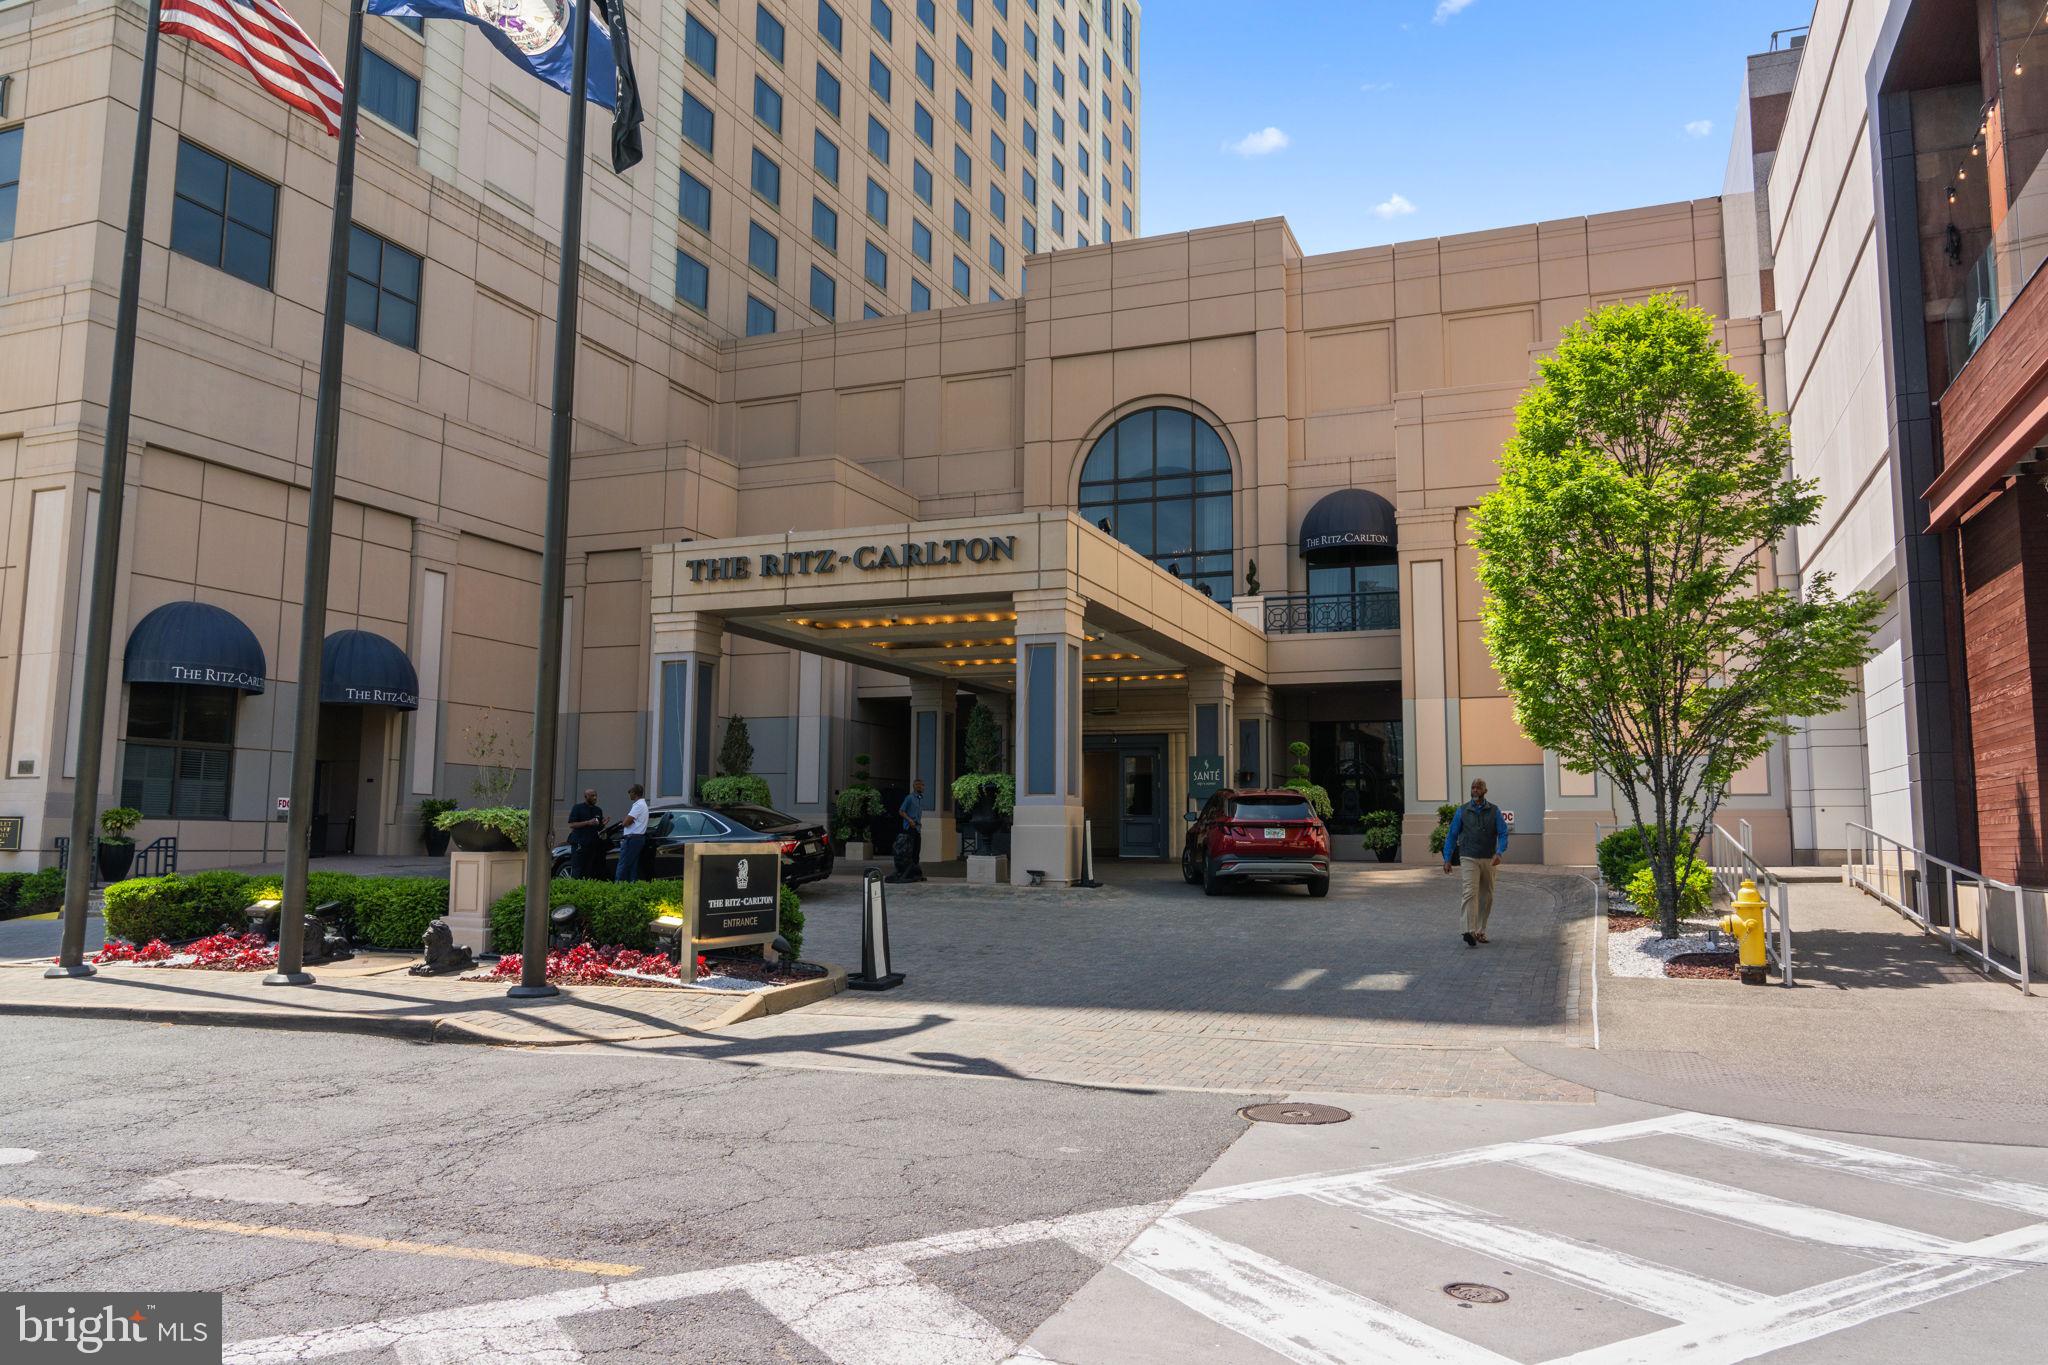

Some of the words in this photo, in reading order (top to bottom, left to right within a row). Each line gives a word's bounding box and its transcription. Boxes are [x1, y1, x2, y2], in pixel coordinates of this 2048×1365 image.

[1306, 538, 1320, 549] THE
[1321, 532, 1388, 545] RITZ-CARLTON
[686, 556, 750, 582] THE
[759, 535, 1016, 577] RITZ-CARLTON
[171, 666, 202, 680] THE
[205, 668, 264, 687] RITZ-CARL
[345, 688, 371, 700] THE
[1193, 768, 1220, 781] SANTÉ
[1502, 812, 1514, 821] DC
[708, 899, 724, 908] THE
[725, 896, 774, 907] RITZ-CARLTON
[723, 916, 758, 928] ENTRANCE
